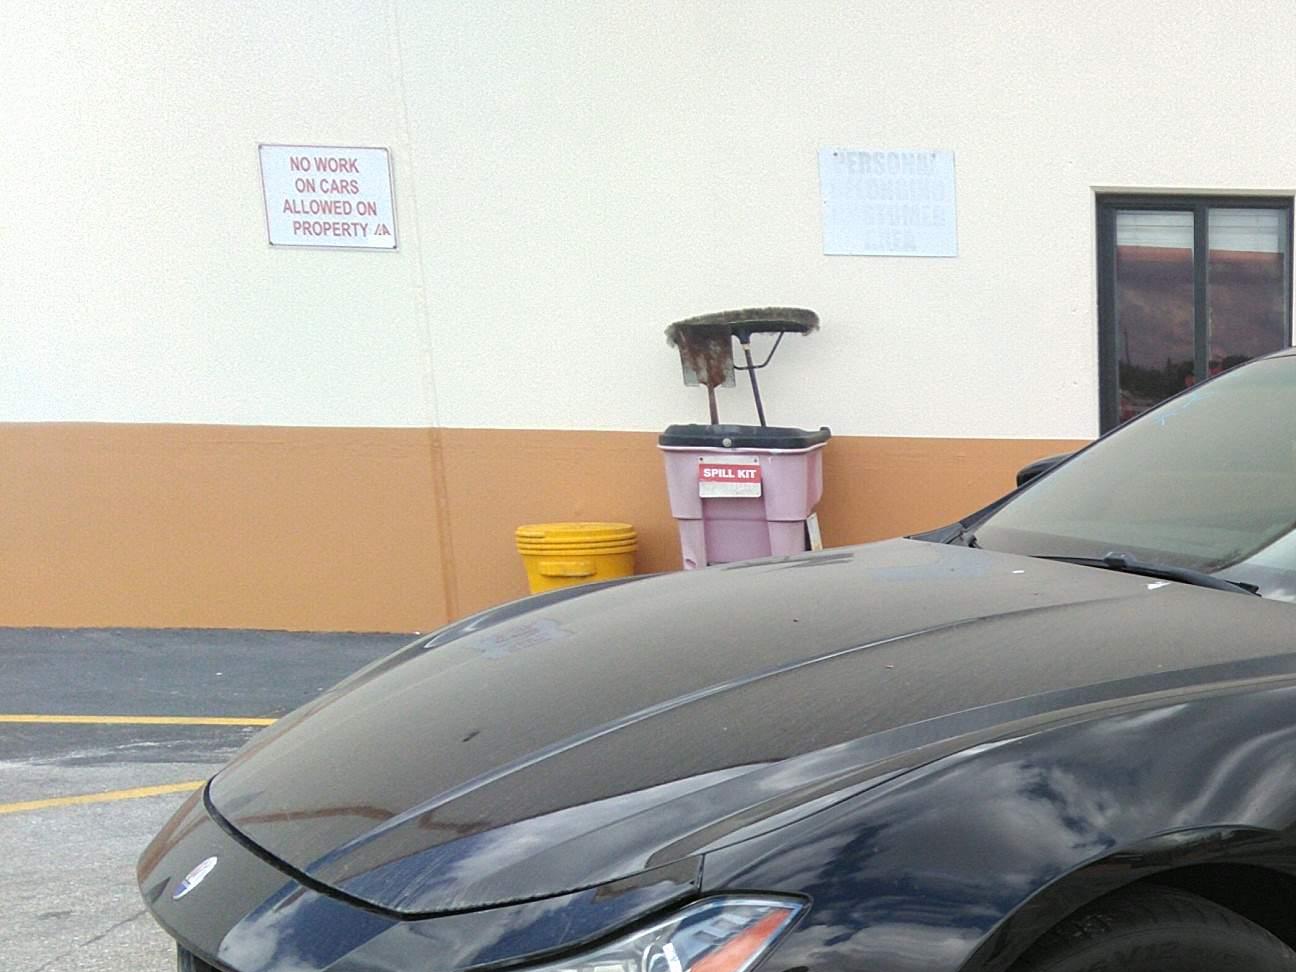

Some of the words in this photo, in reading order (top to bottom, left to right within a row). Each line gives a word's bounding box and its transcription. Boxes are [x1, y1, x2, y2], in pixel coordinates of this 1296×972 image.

[290, 157, 310, 171] NO
[315, 157, 359, 172] WORK
[295, 178, 315, 192] ON
[320, 178, 359, 194] CARS
[283, 199, 352, 215] ALLOWED
[356, 201, 377, 216] ON
[293, 221, 368, 237] PROPERTY
[703, 468, 735, 478] SPILL
[737, 469, 757, 478] KIT
